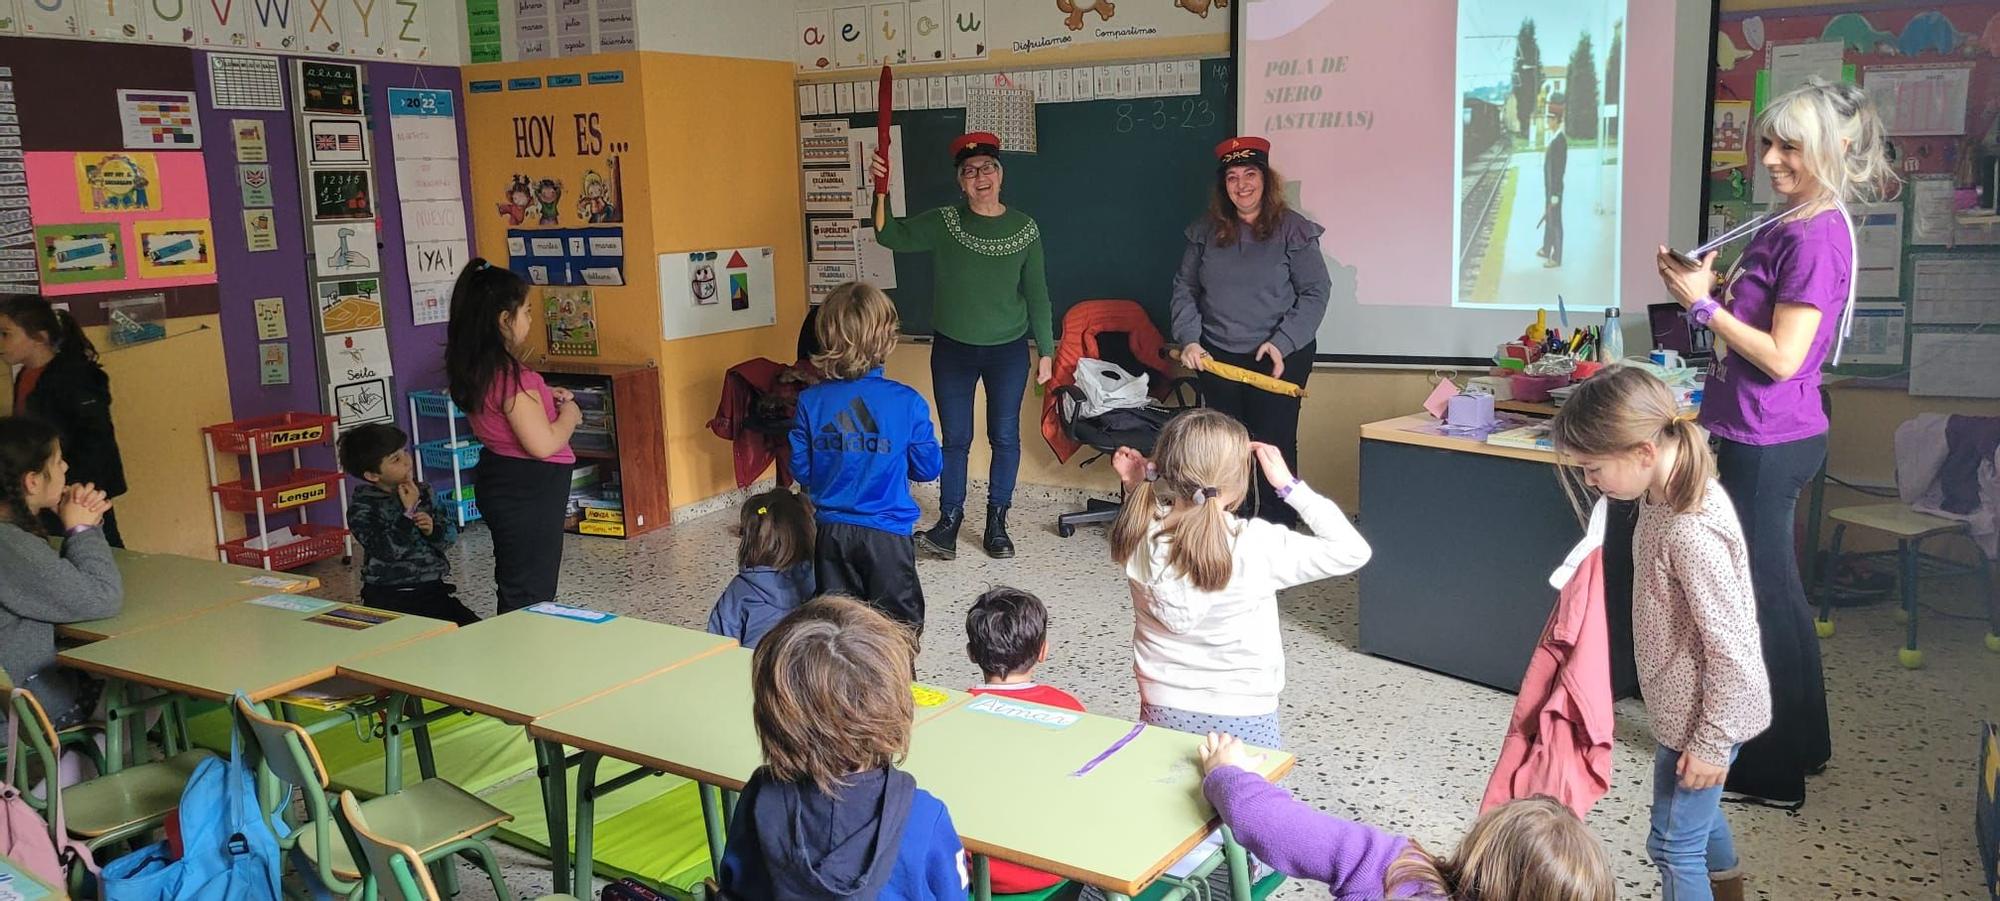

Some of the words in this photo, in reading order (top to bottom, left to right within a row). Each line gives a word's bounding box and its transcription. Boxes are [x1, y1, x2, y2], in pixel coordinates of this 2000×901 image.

[254, 0, 290, 29] W
[309, 0, 333, 34] X
[354, 0, 375, 37] Y
[396, 1, 420, 42] Z
[803, 26, 825, 46] a
[841, 23, 860, 42] e
[882, 9, 896, 41] i
[956, 12, 981, 32] u
[1095, 26, 1157, 39] Compartimos
[1013, 35, 1073, 53] Disfrutamos
[1264, 58, 1314, 78] POLA
[1321, 56, 1349, 74] DE
[406, 98, 436, 108] 2022
[1264, 85, 1323, 104] SIERO
[1264, 111, 1374, 134] (ASTURIAS)
[512, 115, 557, 158] HOY
[573, 240, 580, 253] 7
[416, 244, 454, 275] ¡YA!
[272, 430, 320, 444] Mate
[814, 432, 891, 453] adidas
[279, 488, 324, 504] Lengua
